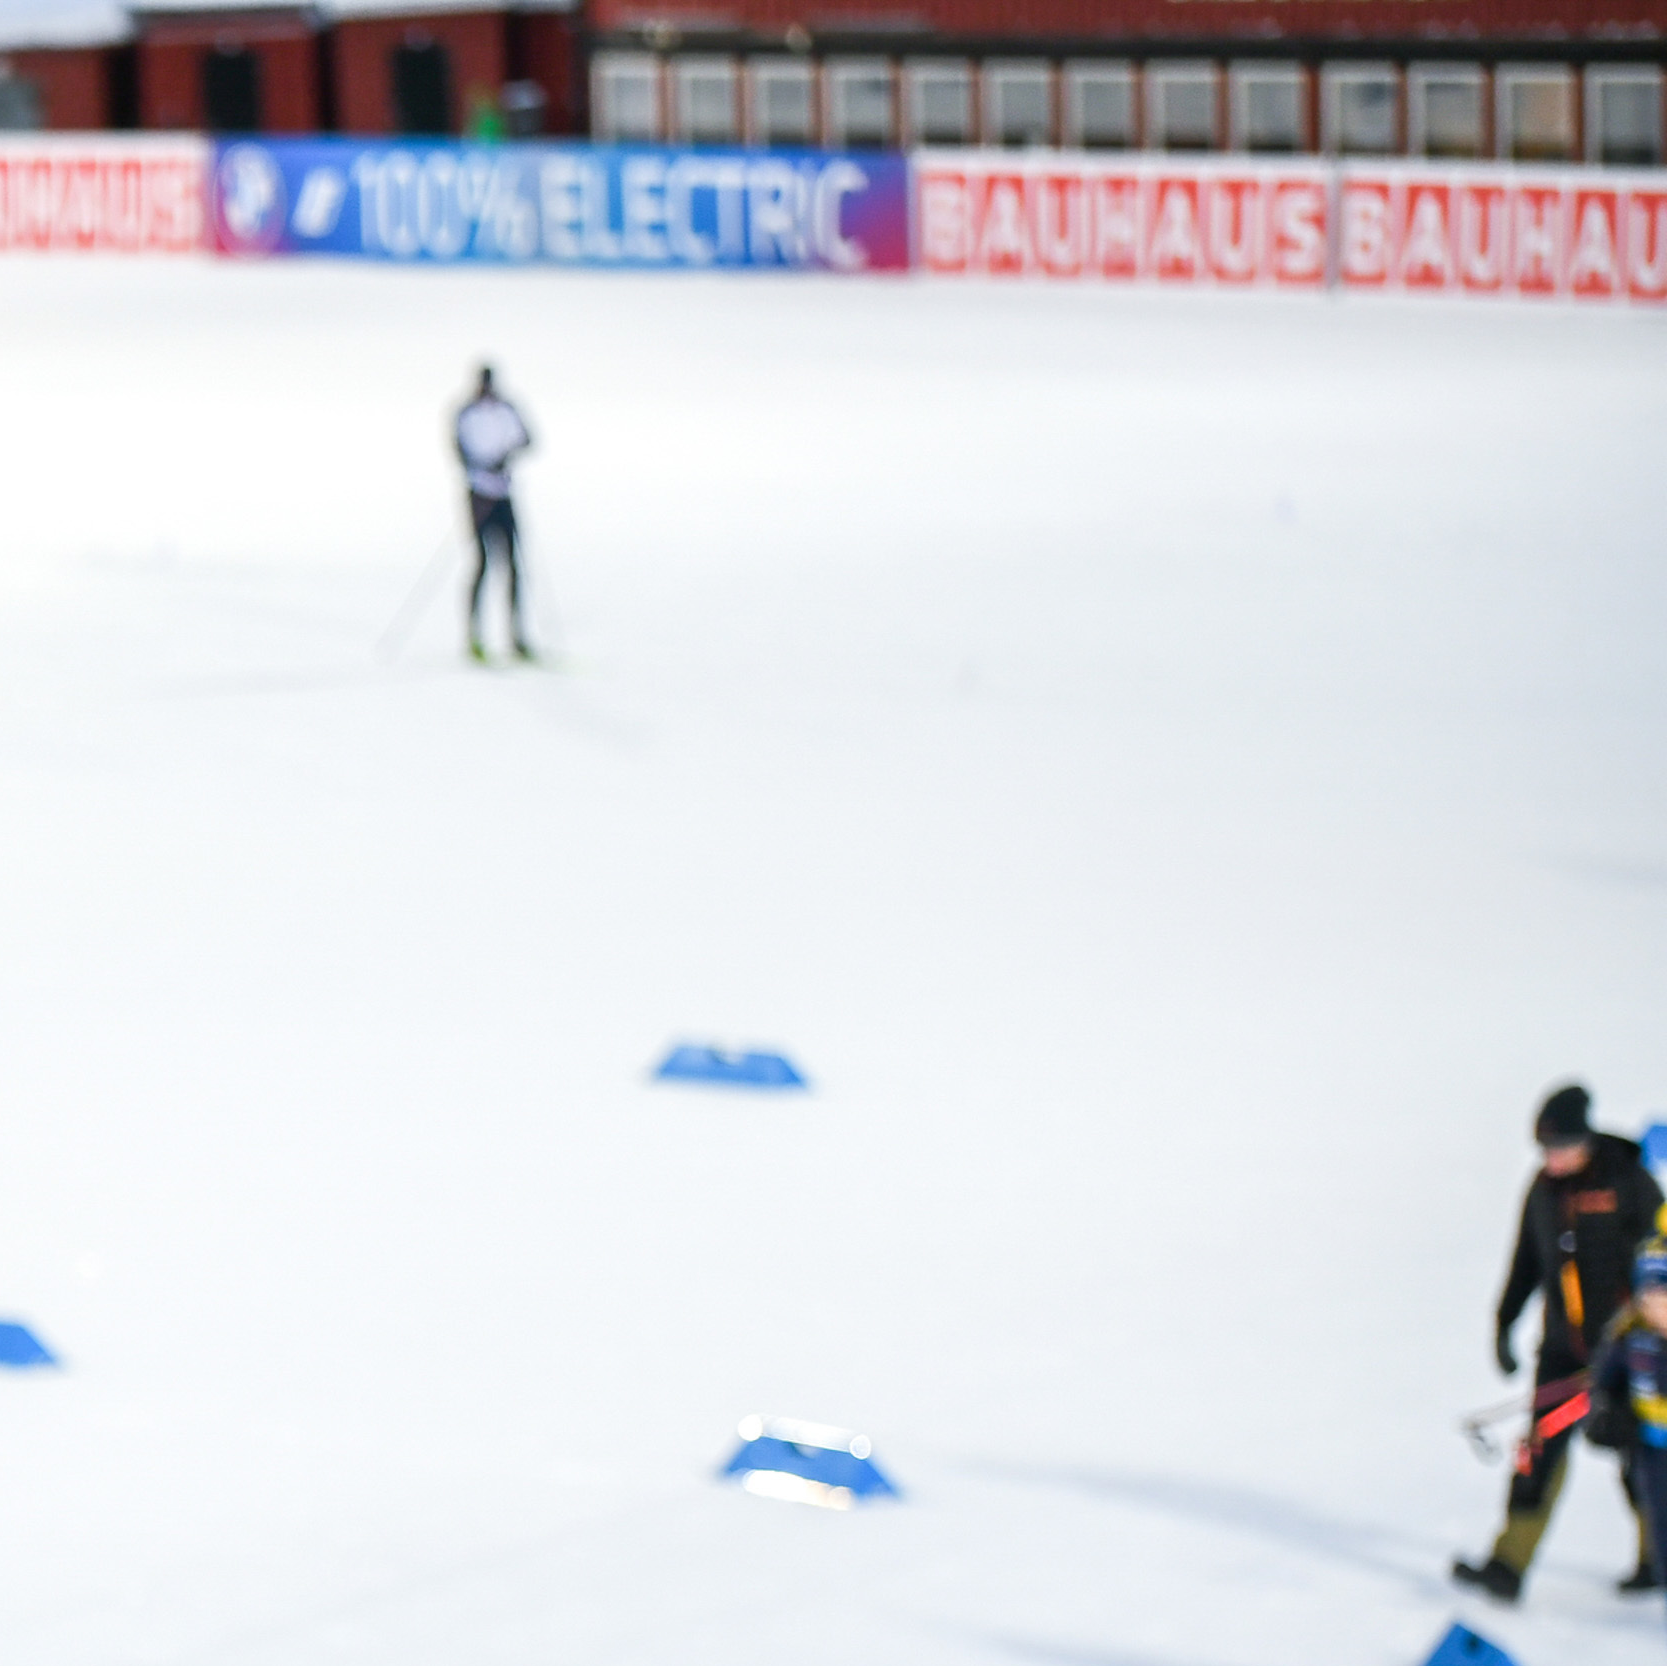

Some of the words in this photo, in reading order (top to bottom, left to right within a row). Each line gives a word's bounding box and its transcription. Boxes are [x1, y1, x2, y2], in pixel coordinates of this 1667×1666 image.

[351, 150, 540, 260] 100%
[541, 155, 867, 268] ELECTRIC
[921, 176, 1327, 280] BAUHAUS
[1341, 182, 1667, 293] BAUHAU
